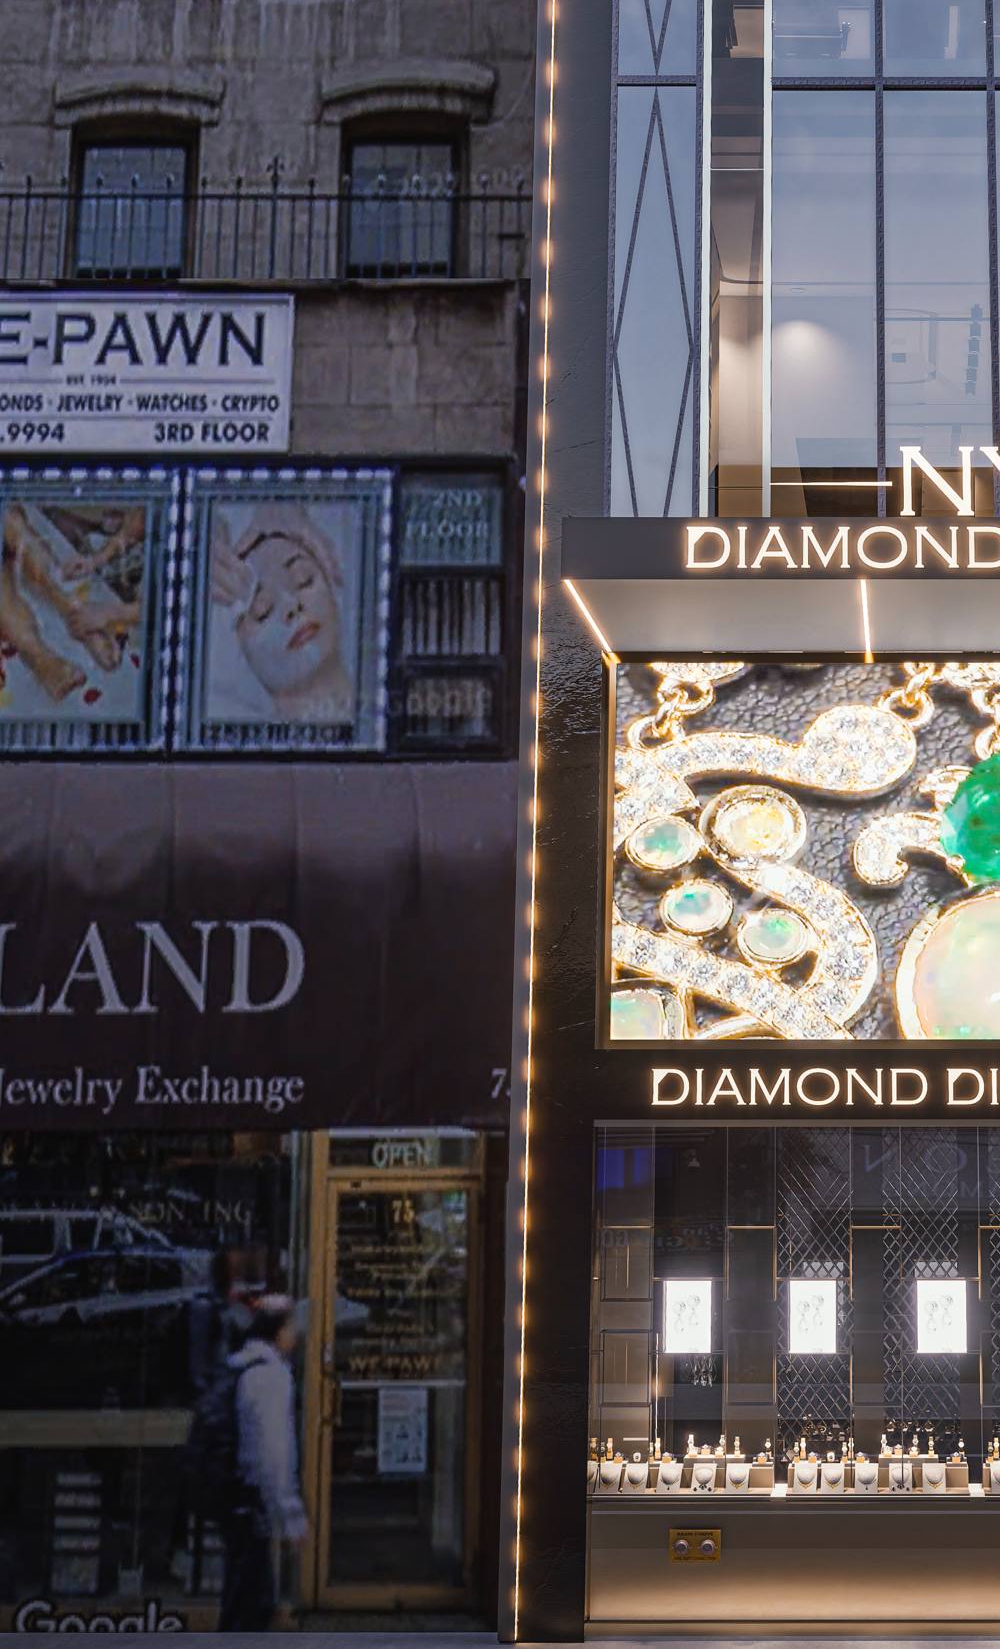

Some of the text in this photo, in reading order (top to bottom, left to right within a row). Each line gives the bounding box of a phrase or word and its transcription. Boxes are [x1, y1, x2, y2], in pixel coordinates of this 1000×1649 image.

[57, 394, 124, 413] JEWELRY
[136, 394, 208, 413] WATCHES
[221, 394, 280, 413] CRYPTO
[154, 422, 194, 443] 3RD
[201, 422, 269, 443] FLOOR
[0, 919, 304, 1015] LAND
[136, 1066, 304, 1114] Exchange
[651, 1067, 928, 1107] DIAMOND
[372, 1141, 431, 1168] OPEN
